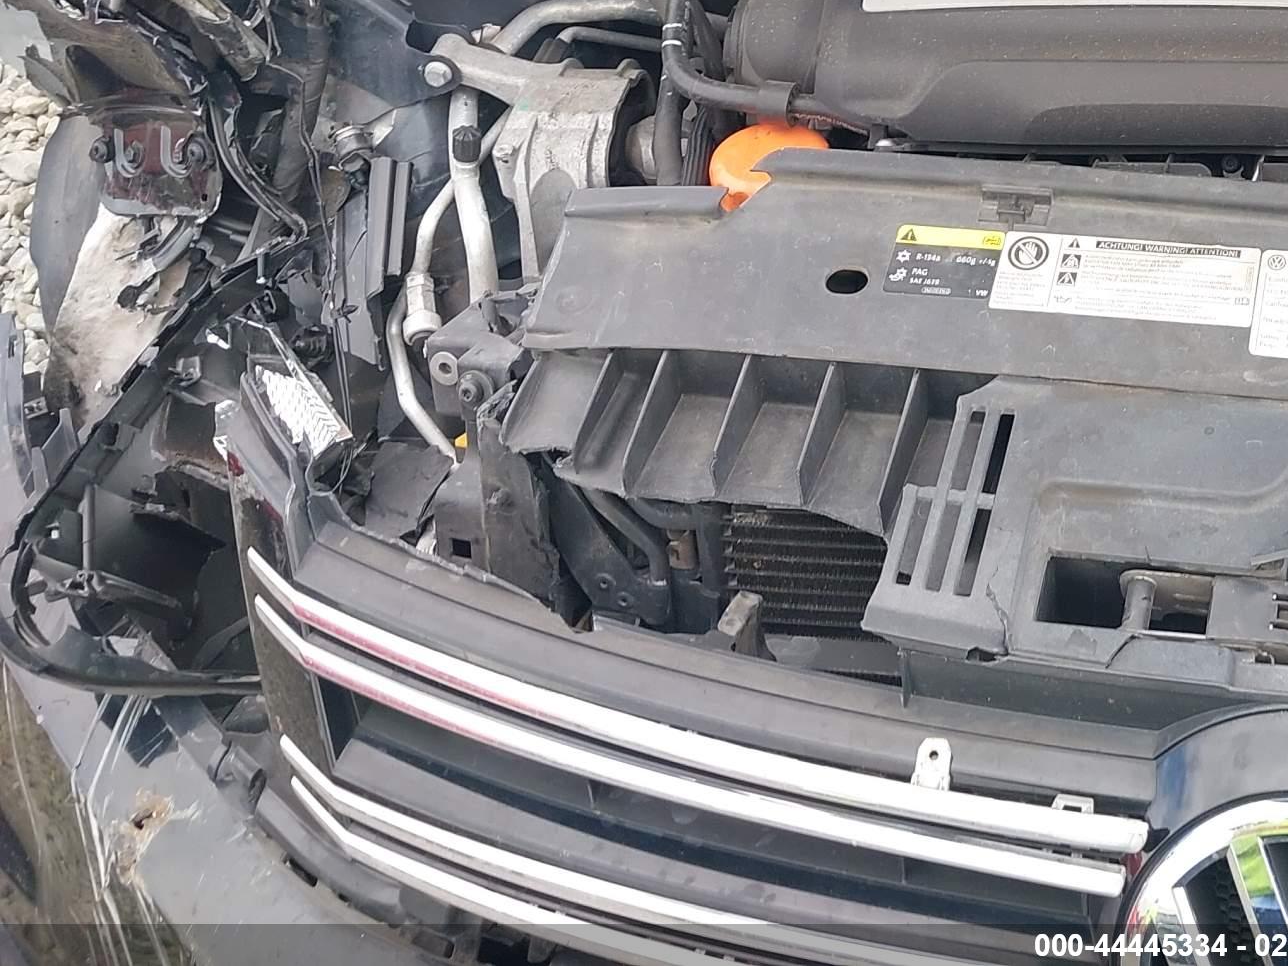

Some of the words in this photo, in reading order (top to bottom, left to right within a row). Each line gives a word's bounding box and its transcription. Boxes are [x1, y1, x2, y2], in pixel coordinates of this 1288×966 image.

[1098, 240, 1143, 252] ACHTUNG!
[1145, 243, 1187, 254] WARNING!
[1189, 246, 1239, 258] ATTENTION!
[911, 267, 928, 276] PAG
